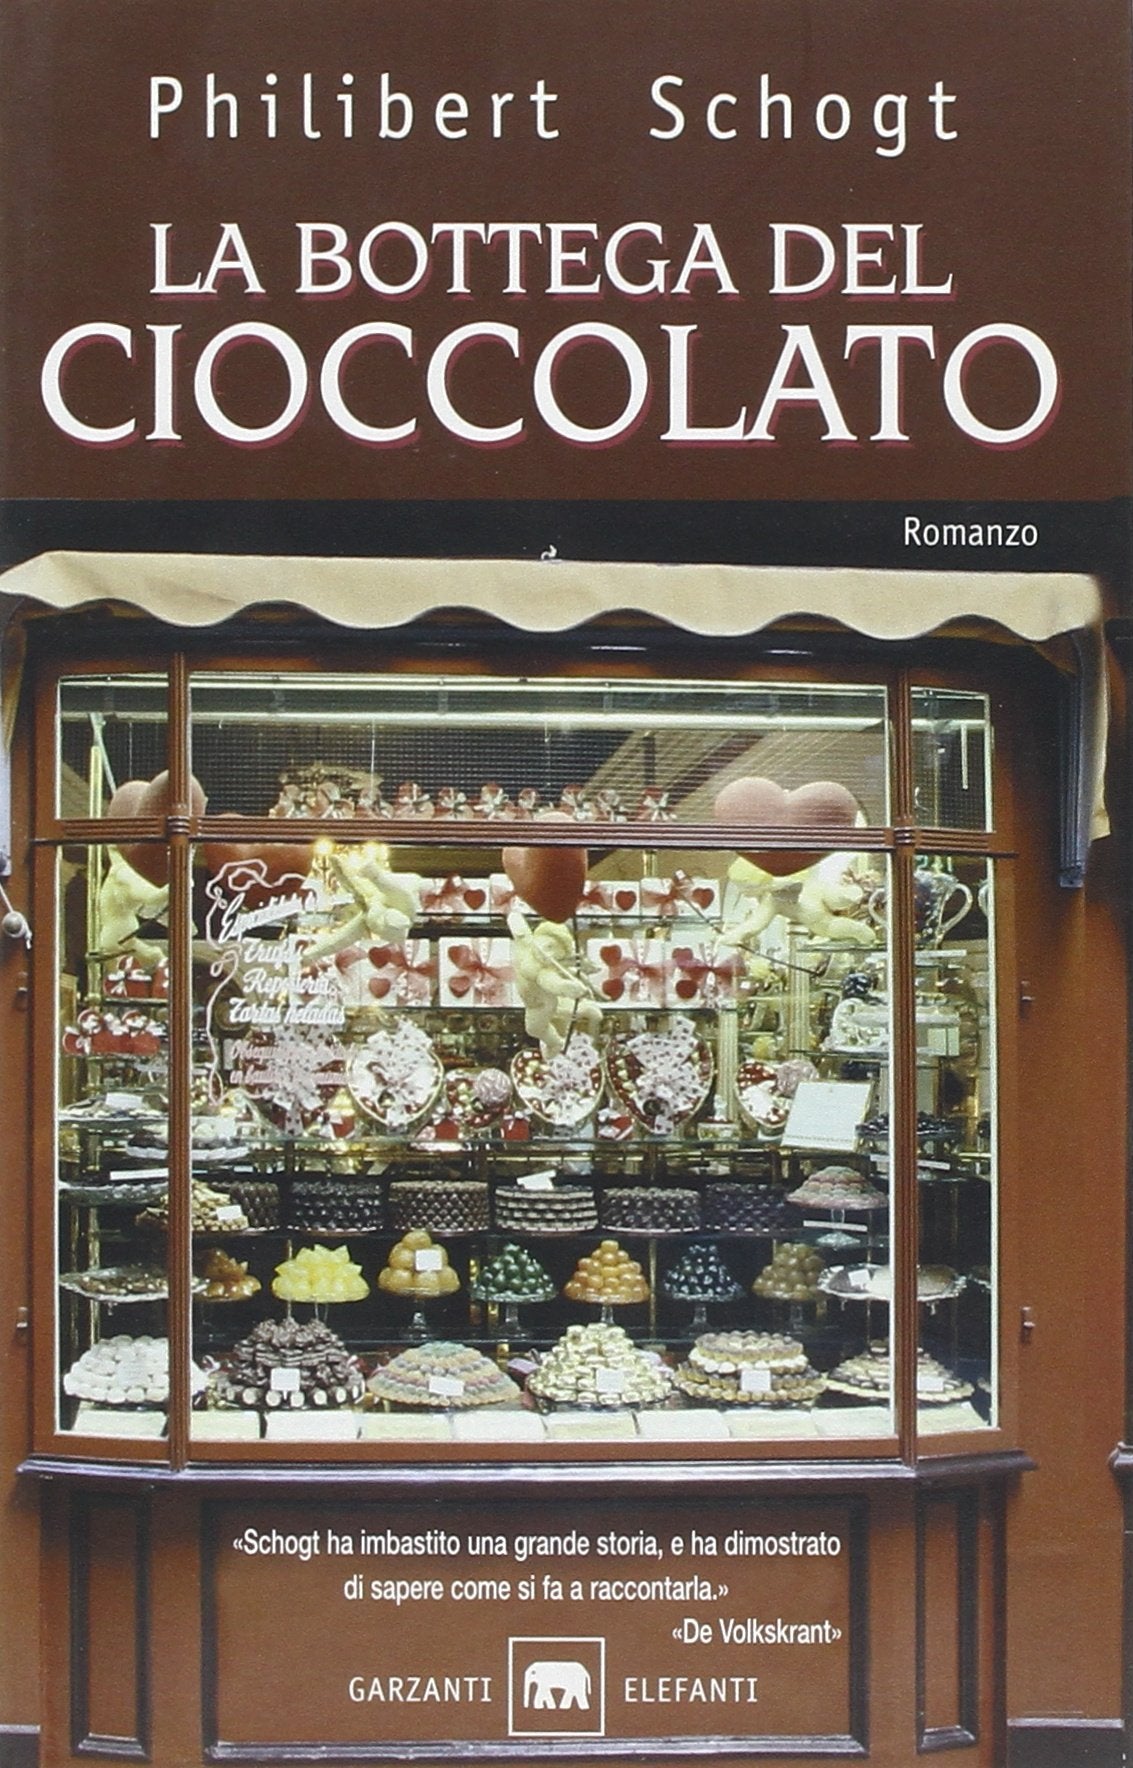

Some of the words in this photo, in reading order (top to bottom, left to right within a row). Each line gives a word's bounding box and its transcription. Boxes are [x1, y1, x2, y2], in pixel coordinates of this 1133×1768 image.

[150, 73, 559, 139] Philibert
[649, 74, 958, 158] Schogt
[150, 223, 267, 296] LA
[296, 221, 740, 297] BOTTEGA
[769, 223, 954, 296] DEL
[41, 321, 1060, 446] CIOCCOLATO
[904, 516, 1038, 546] Romanzo
[233, 1529, 320, 1561] «Schogt
[327, 1529, 354, 1555] ha
[360, 1529, 461, 1555] imbastito
[468, 1535, 508, 1556] una
[514, 1530, 590, 1562] grande
[596, 1529, 663, 1560] storia,
[670, 1536, 684, 1556] e
[691, 1530, 718, 1556] ha
[724, 1530, 841, 1556] dimostrato
[343, 1574, 364, 1600] di
[370, 1580, 444, 1606] sapere
[450, 1580, 511, 1601] come
[518, 1574, 535, 1601] si
[541, 1574, 564, 1601] fa
[570, 1580, 584, 1601] a
[590, 1574, 730, 1602] raccontarla.»
[671, 1618, 713, 1644] «De
[718, 1618, 842, 1644] Volkskrant»
[348, 1676, 492, 1703] GARZANTI
[624, 1677, 758, 1704] ELEFANTI
